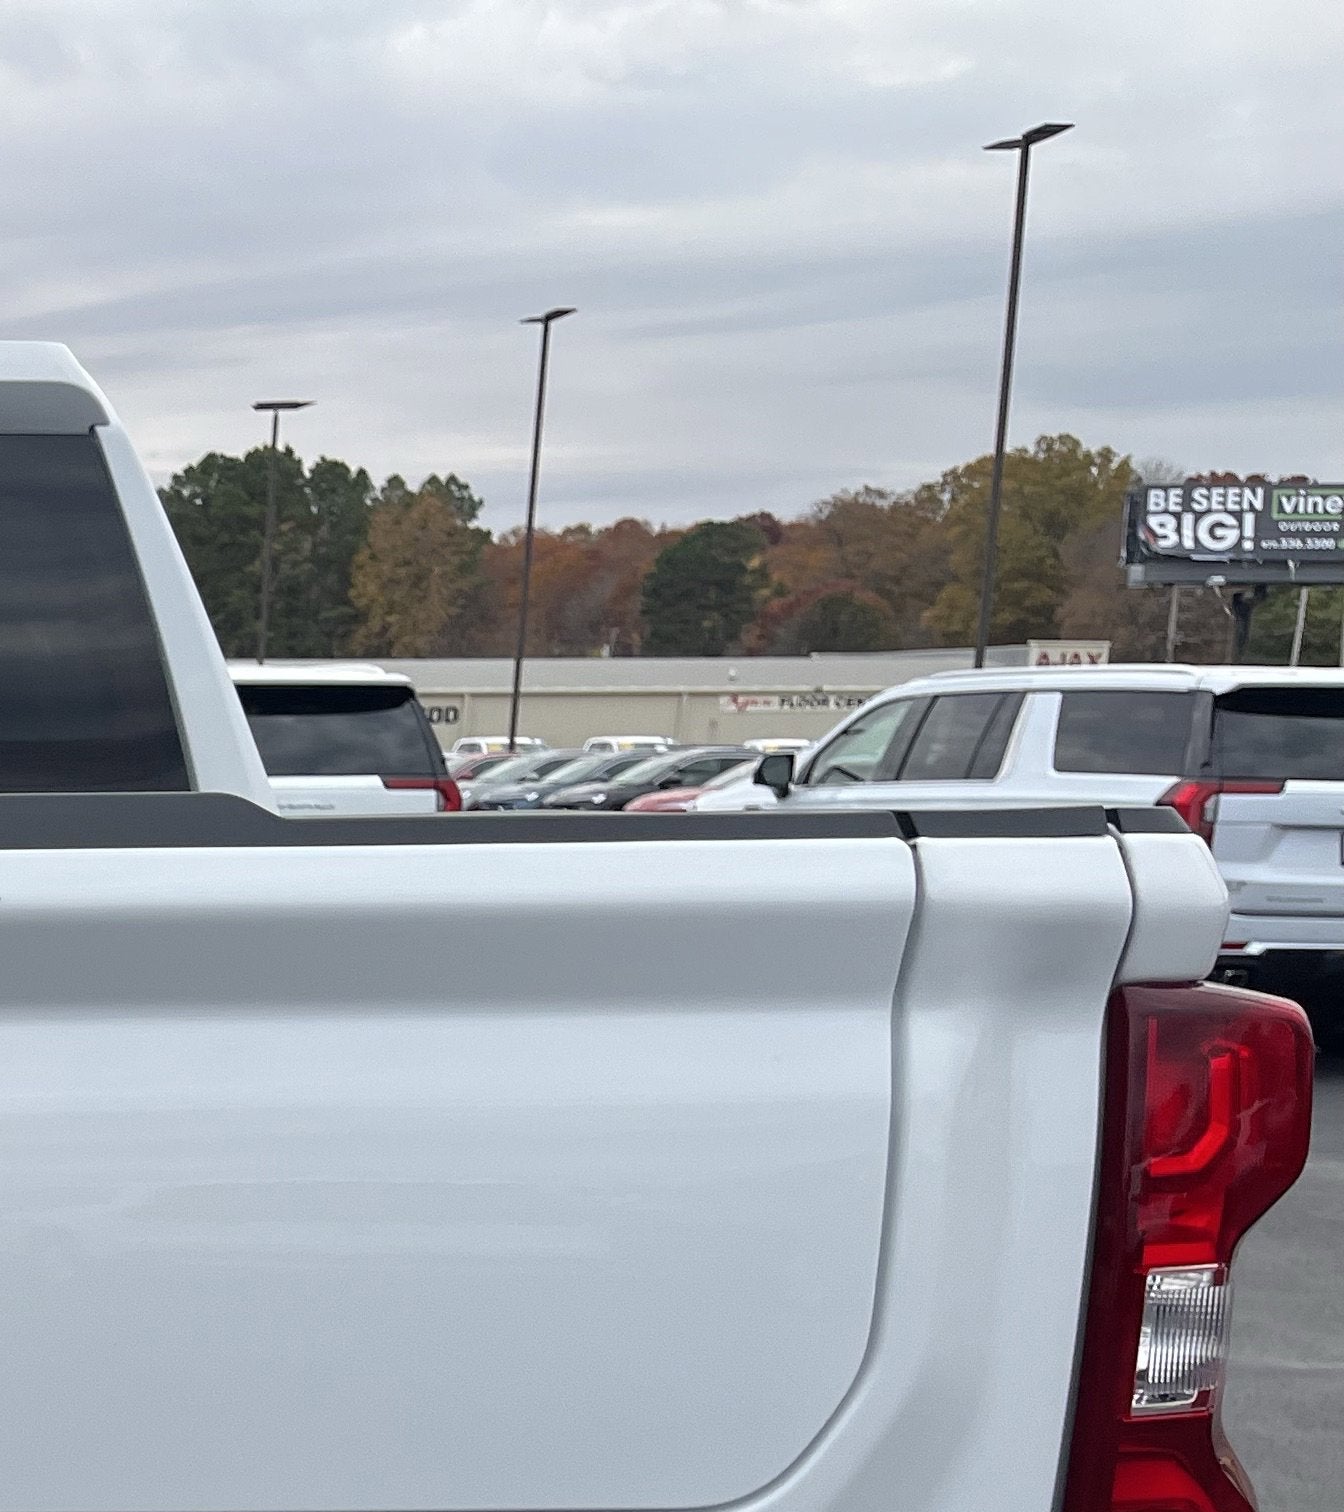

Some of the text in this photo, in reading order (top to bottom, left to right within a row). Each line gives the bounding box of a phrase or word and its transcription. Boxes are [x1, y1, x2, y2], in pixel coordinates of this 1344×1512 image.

[1146, 486, 1265, 513] BE SEEN
[1146, 511, 1256, 551] BIG!
